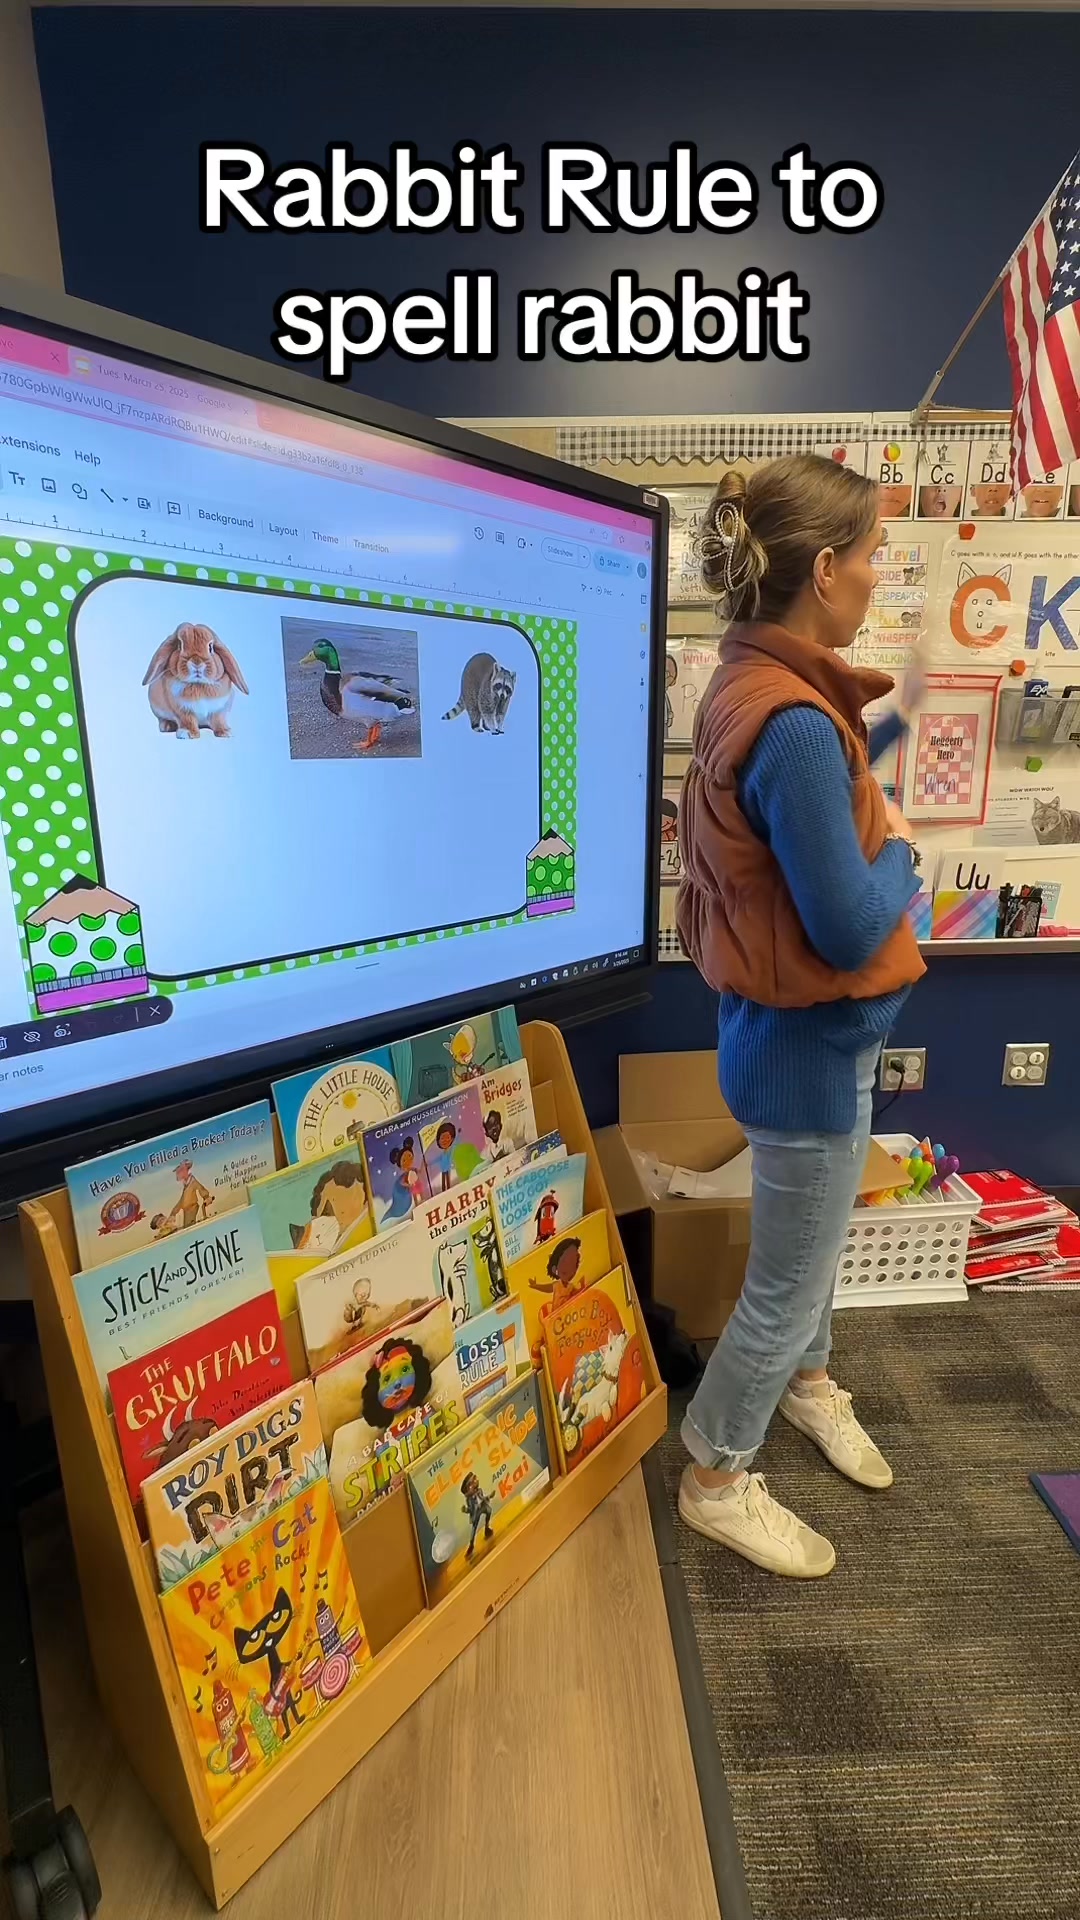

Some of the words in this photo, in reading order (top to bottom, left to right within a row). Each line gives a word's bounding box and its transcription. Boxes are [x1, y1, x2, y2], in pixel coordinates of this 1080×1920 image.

[0, 435, 61, 457] xtensions
[74, 449, 102, 467] Help
[879, 463, 904, 485] Bb
[930, 464, 955, 485] Cc
[980, 462, 1007, 484] Dd
[198, 508, 254, 529] Background
[268, 522, 299, 538] Layout
[311, 530, 339, 545] Theme
[887, 543, 922, 563] Level
[949, 574, 1012, 649] C
[1024, 575, 1080, 651] K
[930, 735, 964, 747] Heggerty
[936, 749, 955, 761] Hero
[954, 862, 991, 891] Uu
[12, 1063, 45, 1079] notes
[480, 1078, 496, 1090] Am
[303, 1098, 323, 1130] THE
[319, 1068, 358, 1100] LITTLE
[362, 1069, 395, 1101] HOUSE
[482, 1078, 522, 1105] Bridges
[374, 1123, 400, 1140] CIARA
[400, 1118, 412, 1129] and
[411, 1105, 442, 1125] RUSSELL
[442, 1092, 469, 1109] WILSON
[89, 1173, 123, 1197] Have
[123, 1160, 146, 1178] You
[149, 1148, 179, 1169] Filled
[180, 1143, 189, 1155] a
[190, 1130, 227, 1152] Bucket
[228, 1119, 267, 1140] Today?
[214, 1173, 232, 1187] Daily
[234, 1160, 268, 1179] Happiness
[230, 1157, 249, 1170] Guide
[495, 1180, 515, 1201] THE
[514, 1159, 570, 1188] CABOOSE
[498, 1189, 526, 1215] WHO
[526, 1178, 551, 1198] GOT
[425, 1175, 497, 1230] HARRY
[501, 1200, 534, 1230] LOOSE
[428, 1224, 448, 1240] the
[449, 1206, 478, 1229] Dirty
[164, 1266, 188, 1285] AND
[183, 1228, 244, 1287] STONE
[504, 1234, 519, 1248] BILL
[506, 1243, 521, 1259] PEET
[321, 1261, 357, 1285] TRUDY
[359, 1239, 399, 1265] LUDWIG
[108, 1318, 137, 1336] BEST
[142, 1293, 190, 1320] FRIENDS
[194, 1267, 245, 1296] FOREVER!
[459, 1331, 500, 1370] LOSS
[556, 1327, 606, 1358] Fergus!
[125, 1324, 278, 1432] GRUFFALO
[140, 1356, 175, 1385] THE
[458, 1351, 499, 1390] RULE
[361, 1430, 394, 1458] BAD
[396, 1401, 432, 1432] CASE
[488, 1406, 538, 1469] SLIDE
[162, 1443, 230, 1510] ROY
[235, 1397, 304, 1462] DIGS
[342, 1399, 460, 1509] STRIPES
[424, 1403, 517, 1512] ELECTRIC
[427, 1458, 446, 1478] THE
[184, 1431, 300, 1545] DIRT
[491, 1463, 507, 1483] AND
[497, 1454, 529, 1501] Kai
[187, 1558, 252, 1617] Pete
[272, 1501, 318, 1549] Cat
[274, 1539, 311, 1572] Rock!
